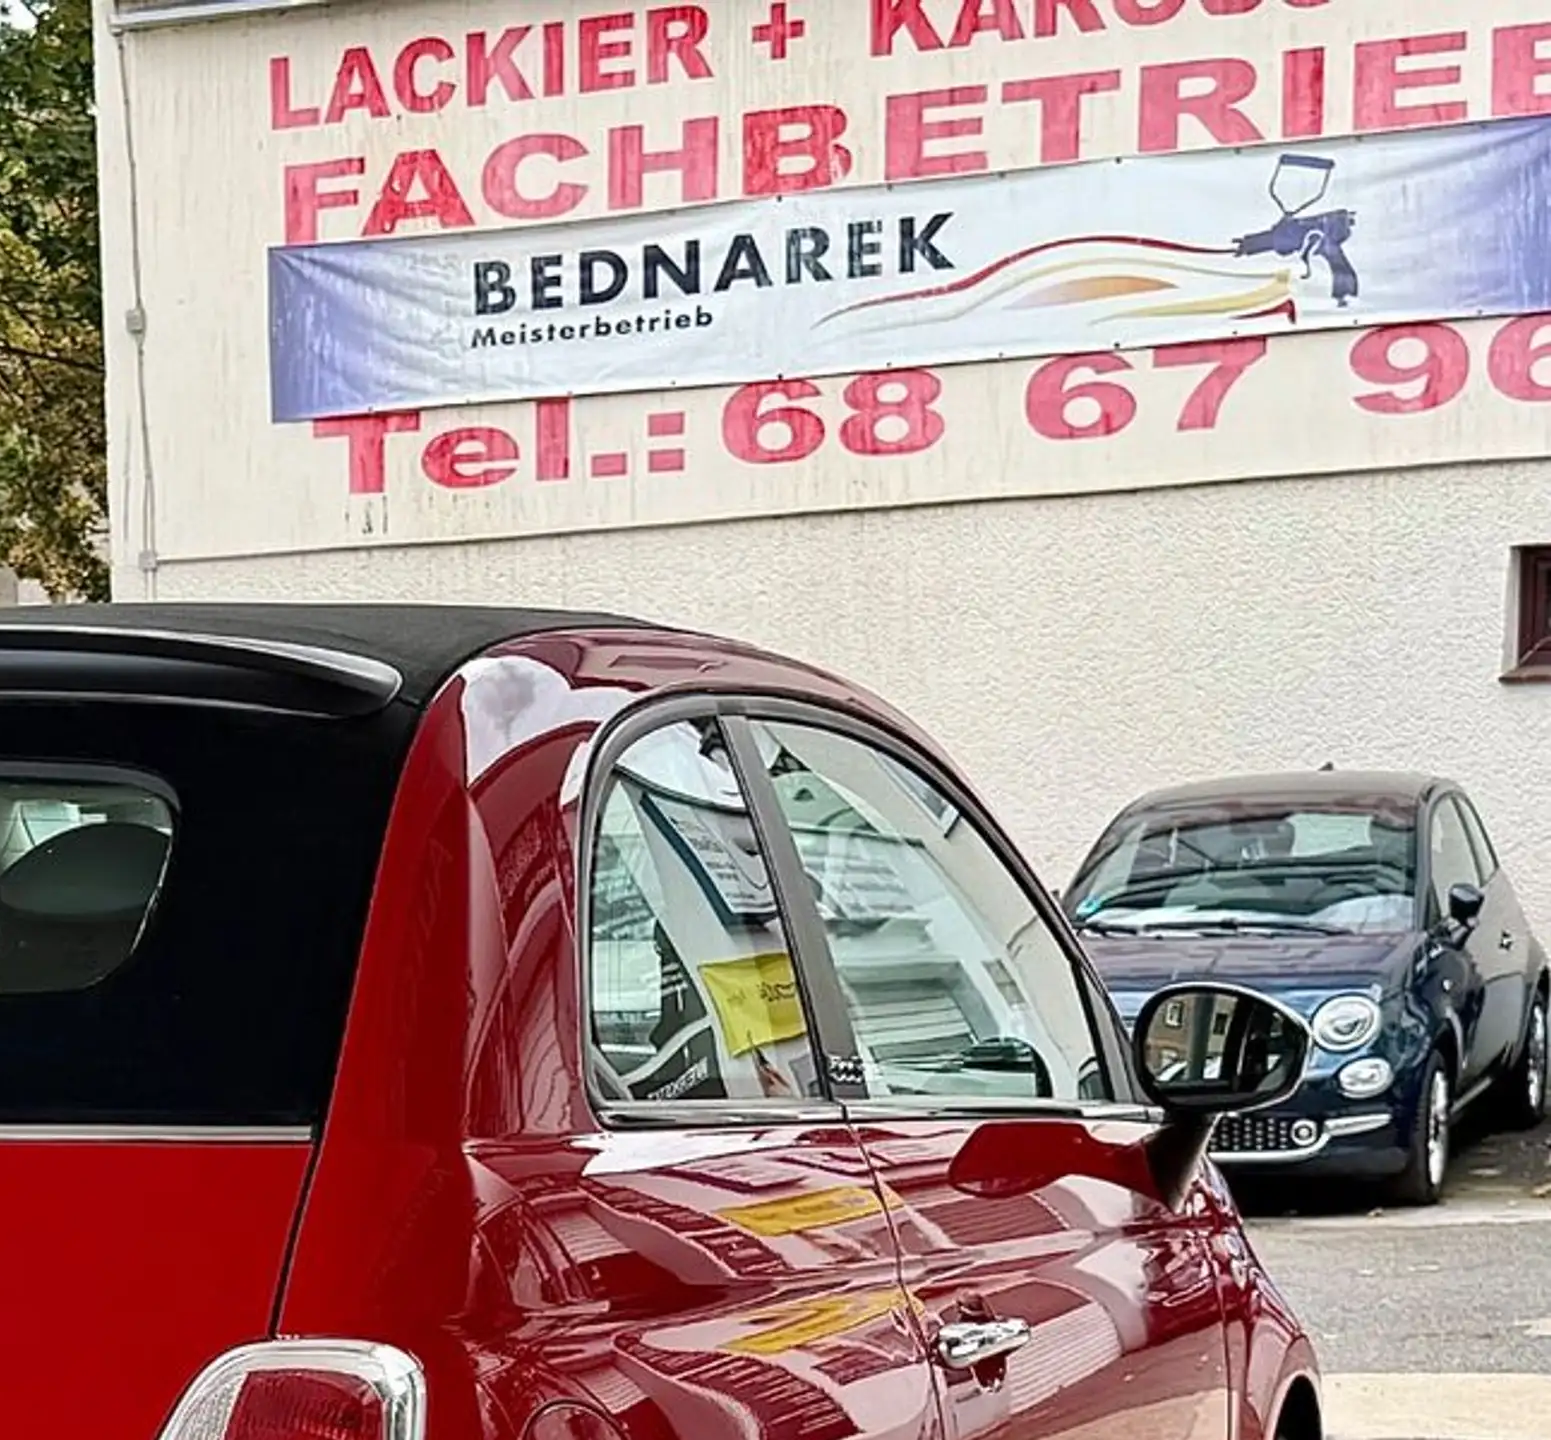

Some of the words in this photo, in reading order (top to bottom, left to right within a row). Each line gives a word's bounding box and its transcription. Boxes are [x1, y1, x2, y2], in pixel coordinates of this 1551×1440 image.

[270, 4, 714, 130] LACKIER
[752, 3, 804, 60] +
[472, 211, 954, 316] BEDNAREK
[470, 306, 714, 349] Meisterbetrieb
[312, 395, 686, 494] Tel.:
[721, 368, 946, 465] 68
[1024, 335, 1268, 440] 67
